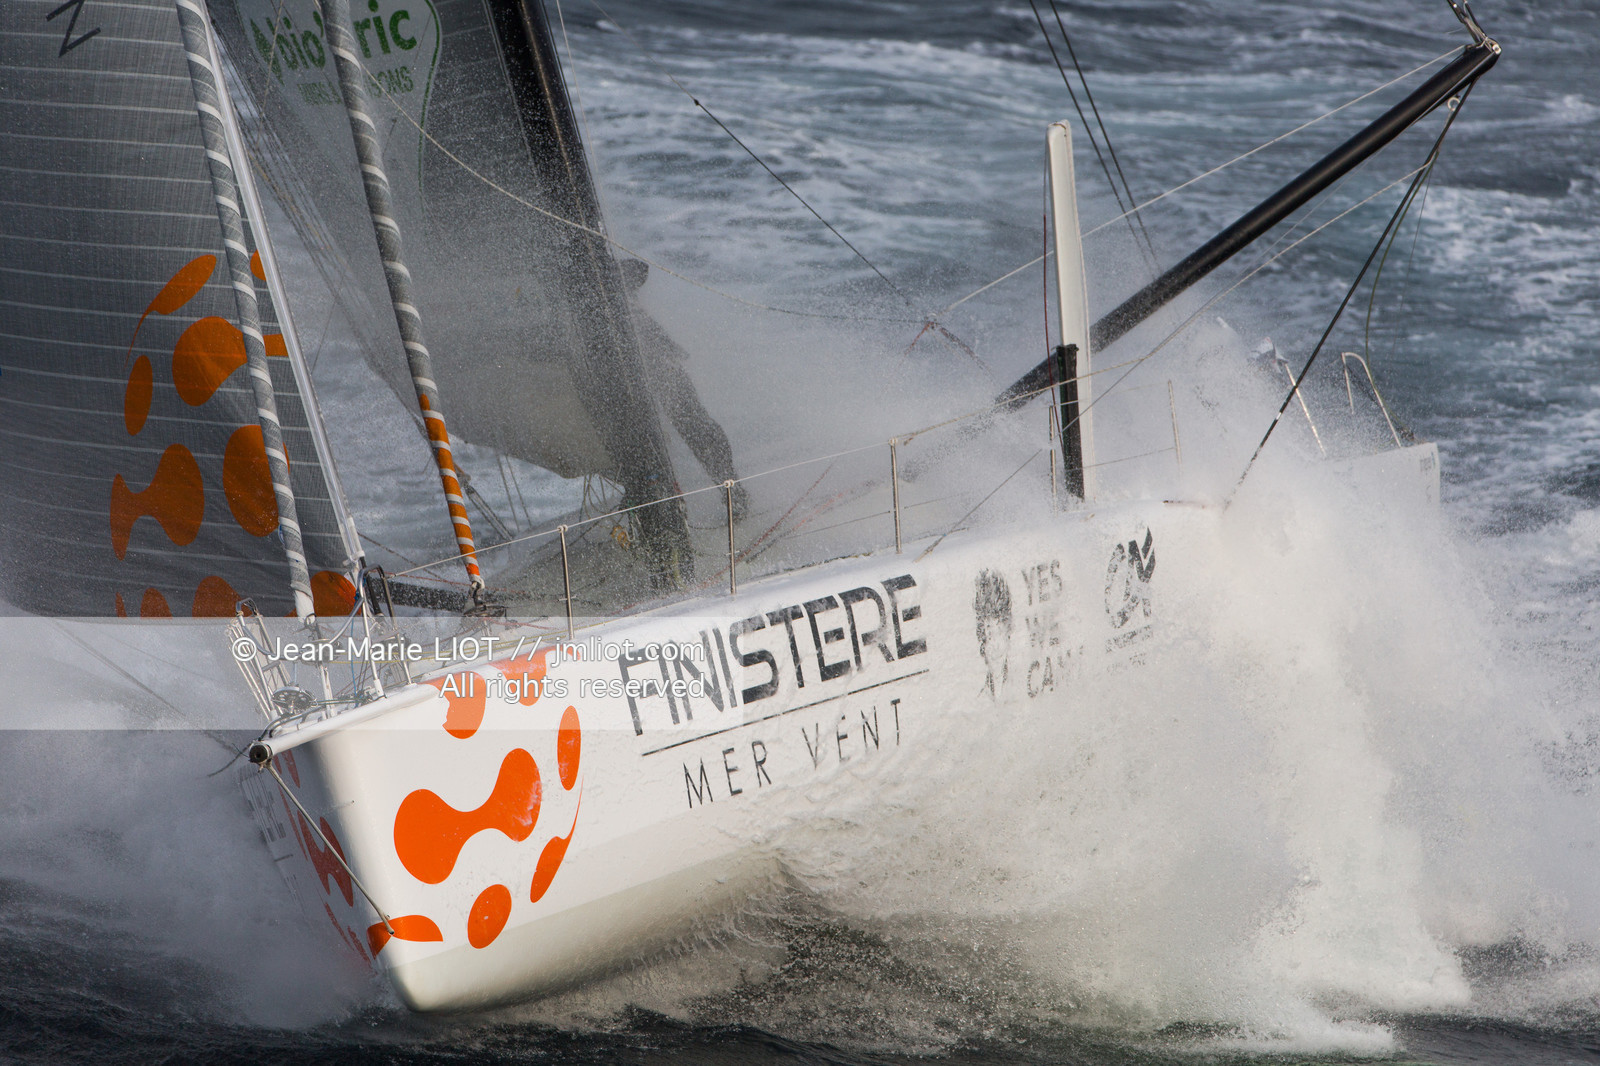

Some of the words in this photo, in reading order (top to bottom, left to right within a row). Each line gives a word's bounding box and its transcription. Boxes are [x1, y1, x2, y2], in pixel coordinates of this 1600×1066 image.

[1021, 559, 1063, 606] YES
[617, 573, 928, 736] FINISTERE
[683, 740, 772, 809] MER
[801, 698, 901, 771] VENT
